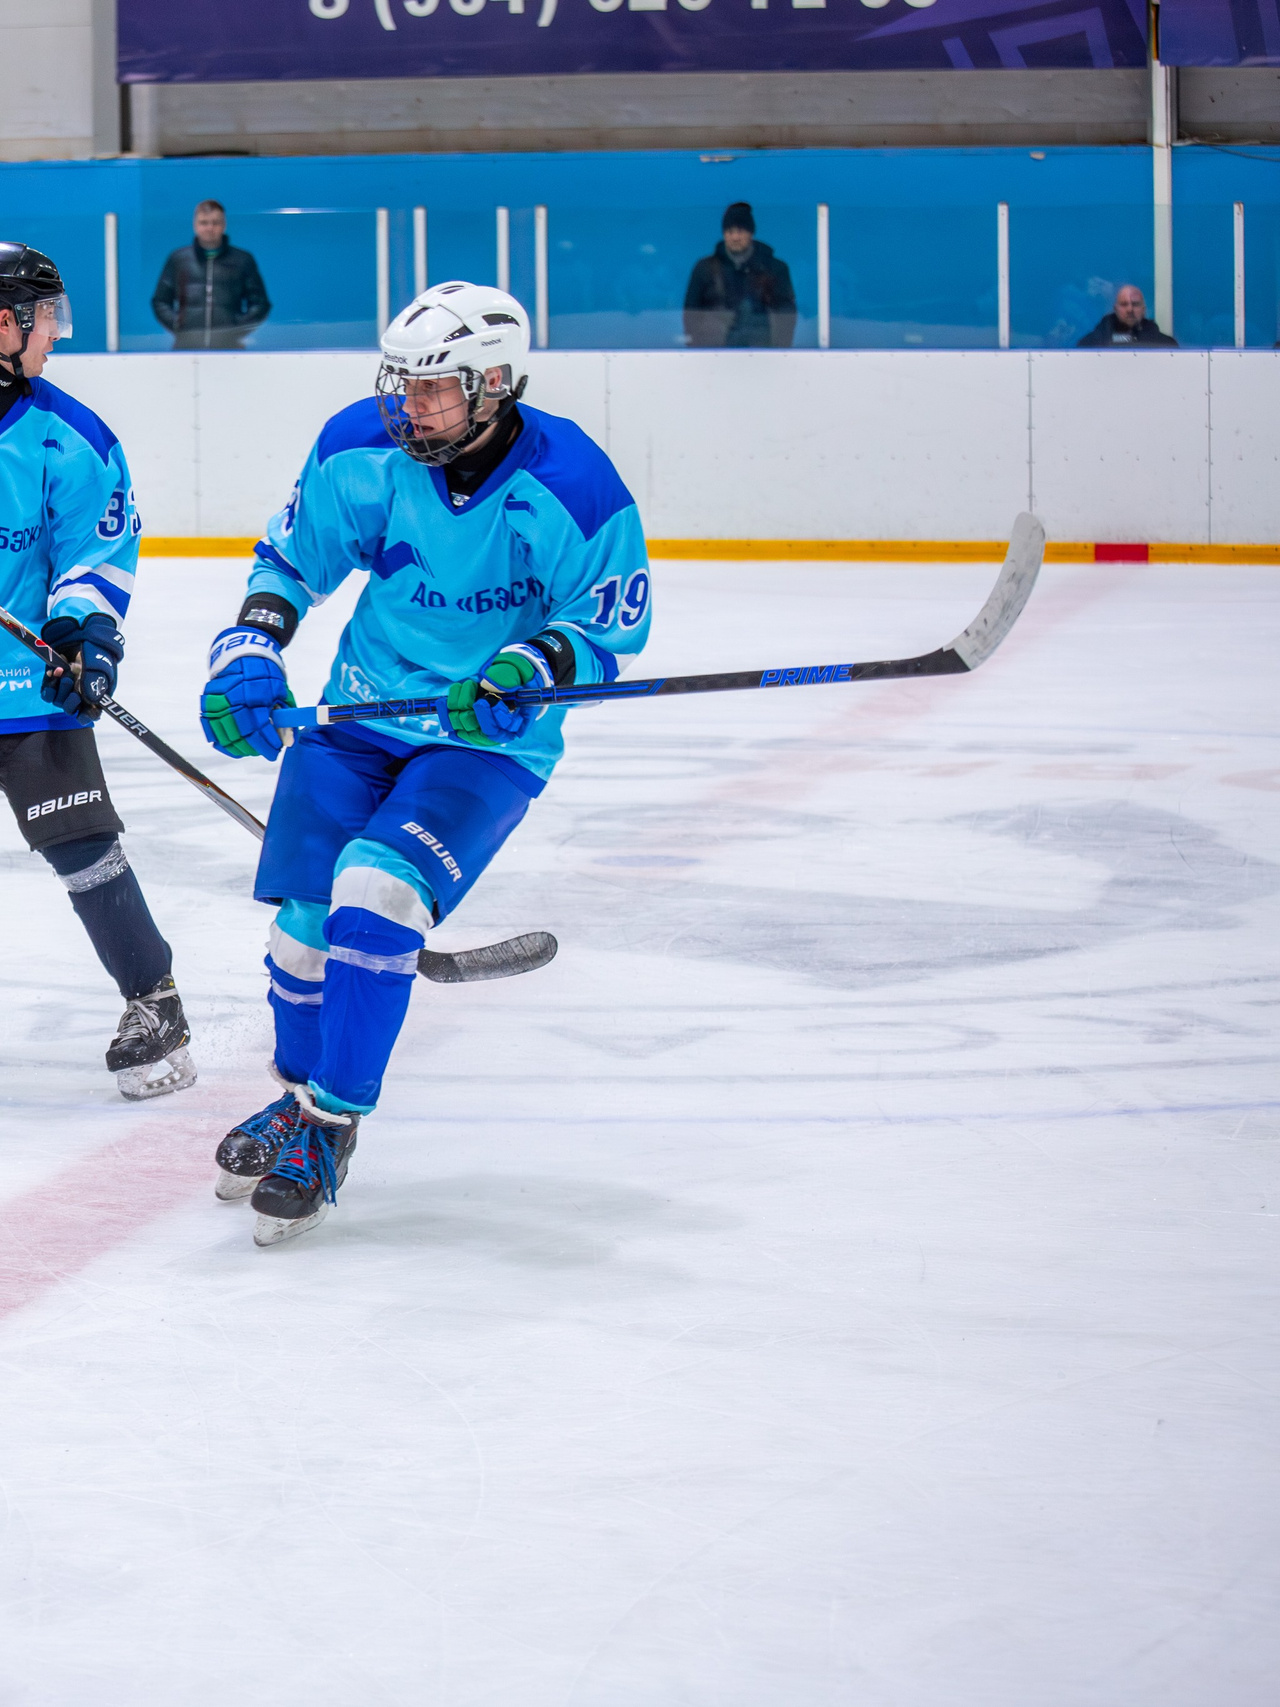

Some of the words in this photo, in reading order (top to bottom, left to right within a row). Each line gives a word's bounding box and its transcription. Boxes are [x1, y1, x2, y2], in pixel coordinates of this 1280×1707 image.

[590, 568, 652, 631] 19
[759, 663, 854, 688] PRIME
[27, 789, 103, 821] BAUER
[400, 821, 463, 883] BAUER
